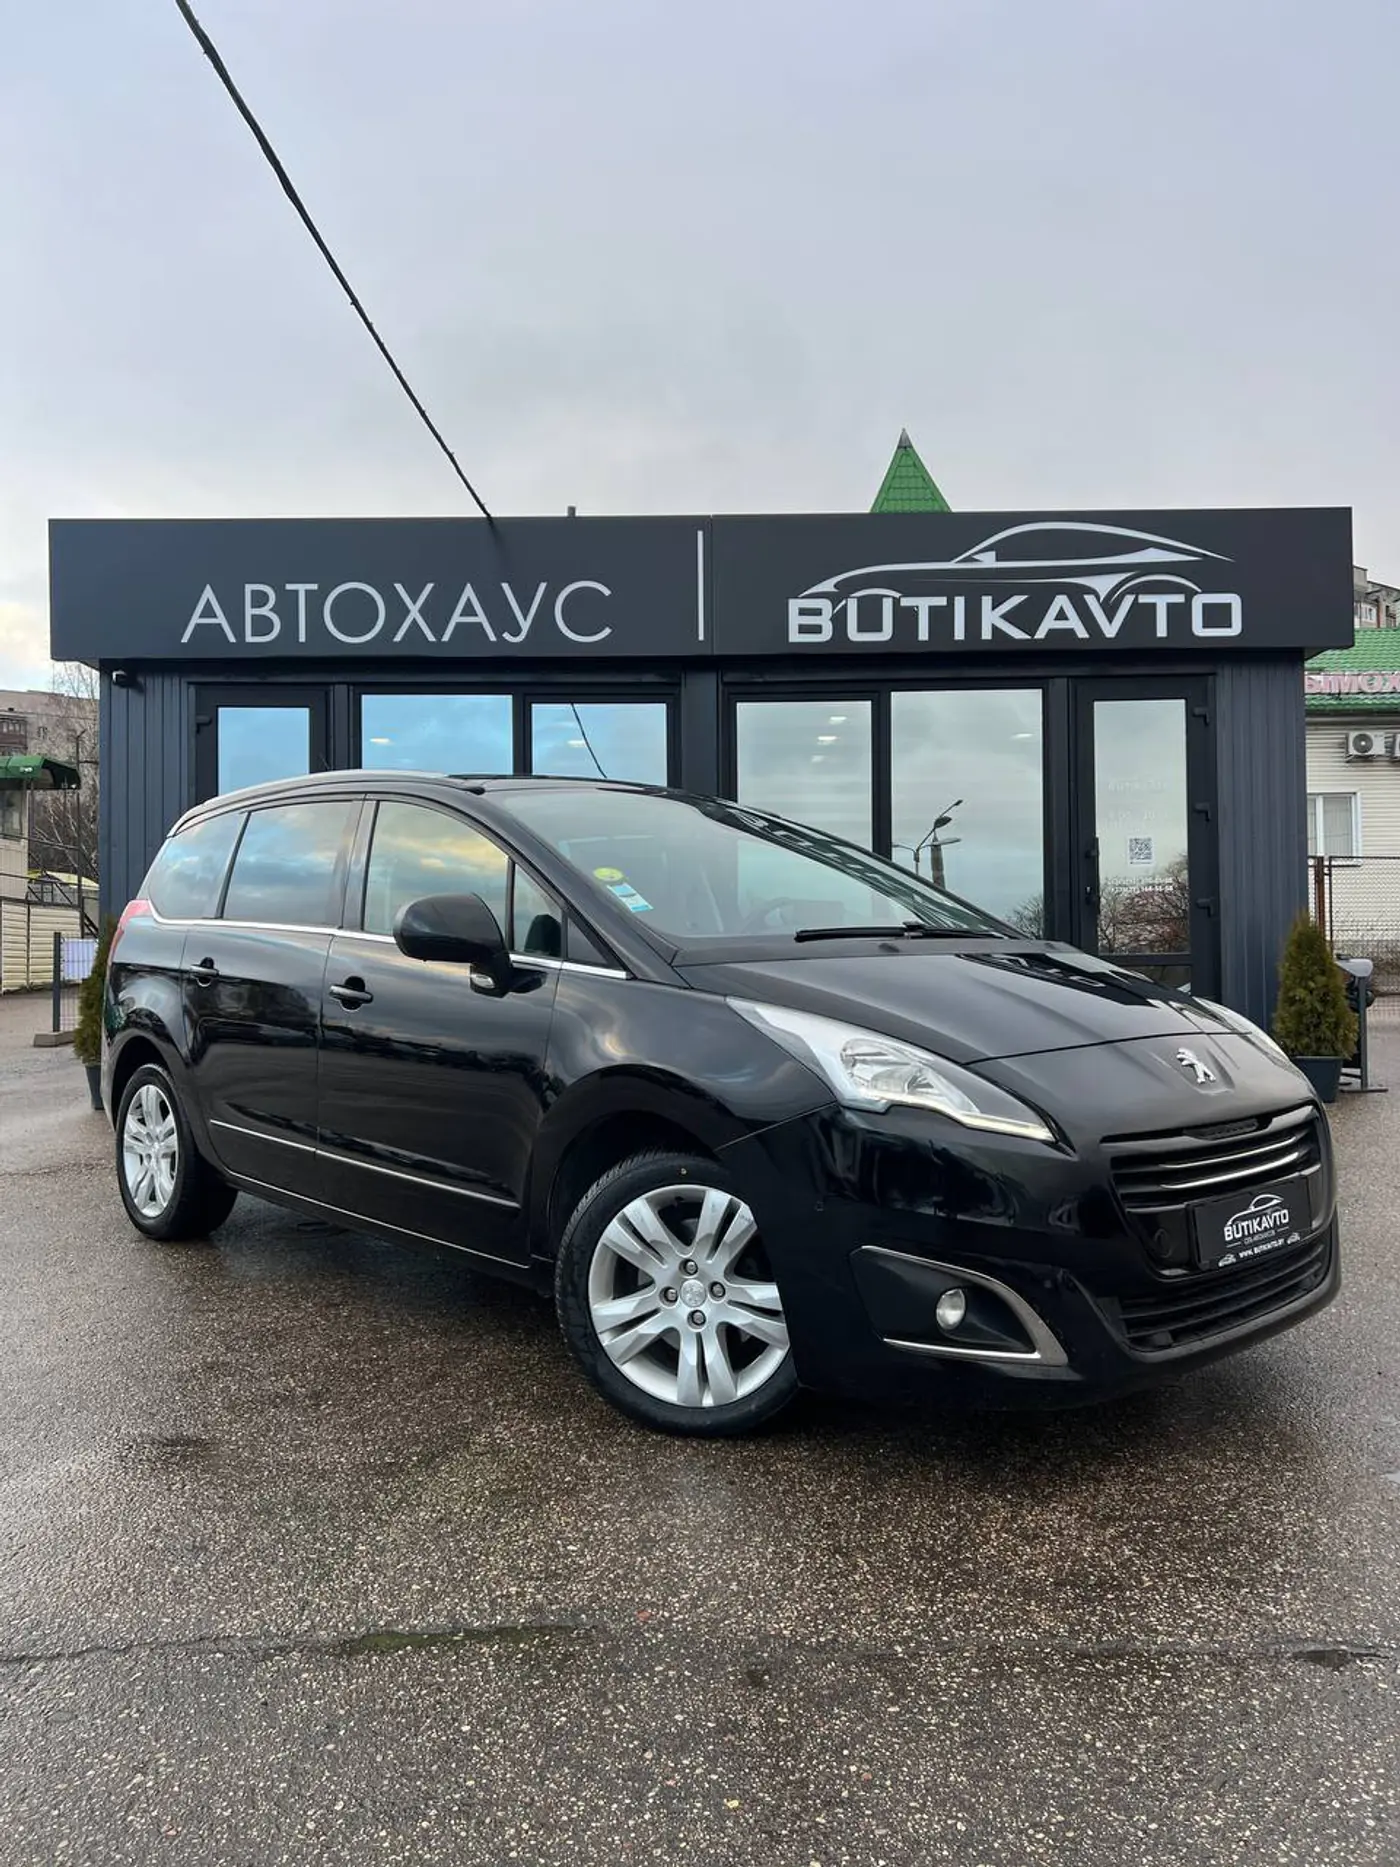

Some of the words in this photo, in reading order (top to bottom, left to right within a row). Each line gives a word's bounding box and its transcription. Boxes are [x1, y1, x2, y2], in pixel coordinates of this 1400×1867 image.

[180, 580, 613, 644] АВТОХАУС
[788, 592, 1242, 643] BUTIKAVTO
[1223, 1209, 1289, 1241] BUTIKAVTO
